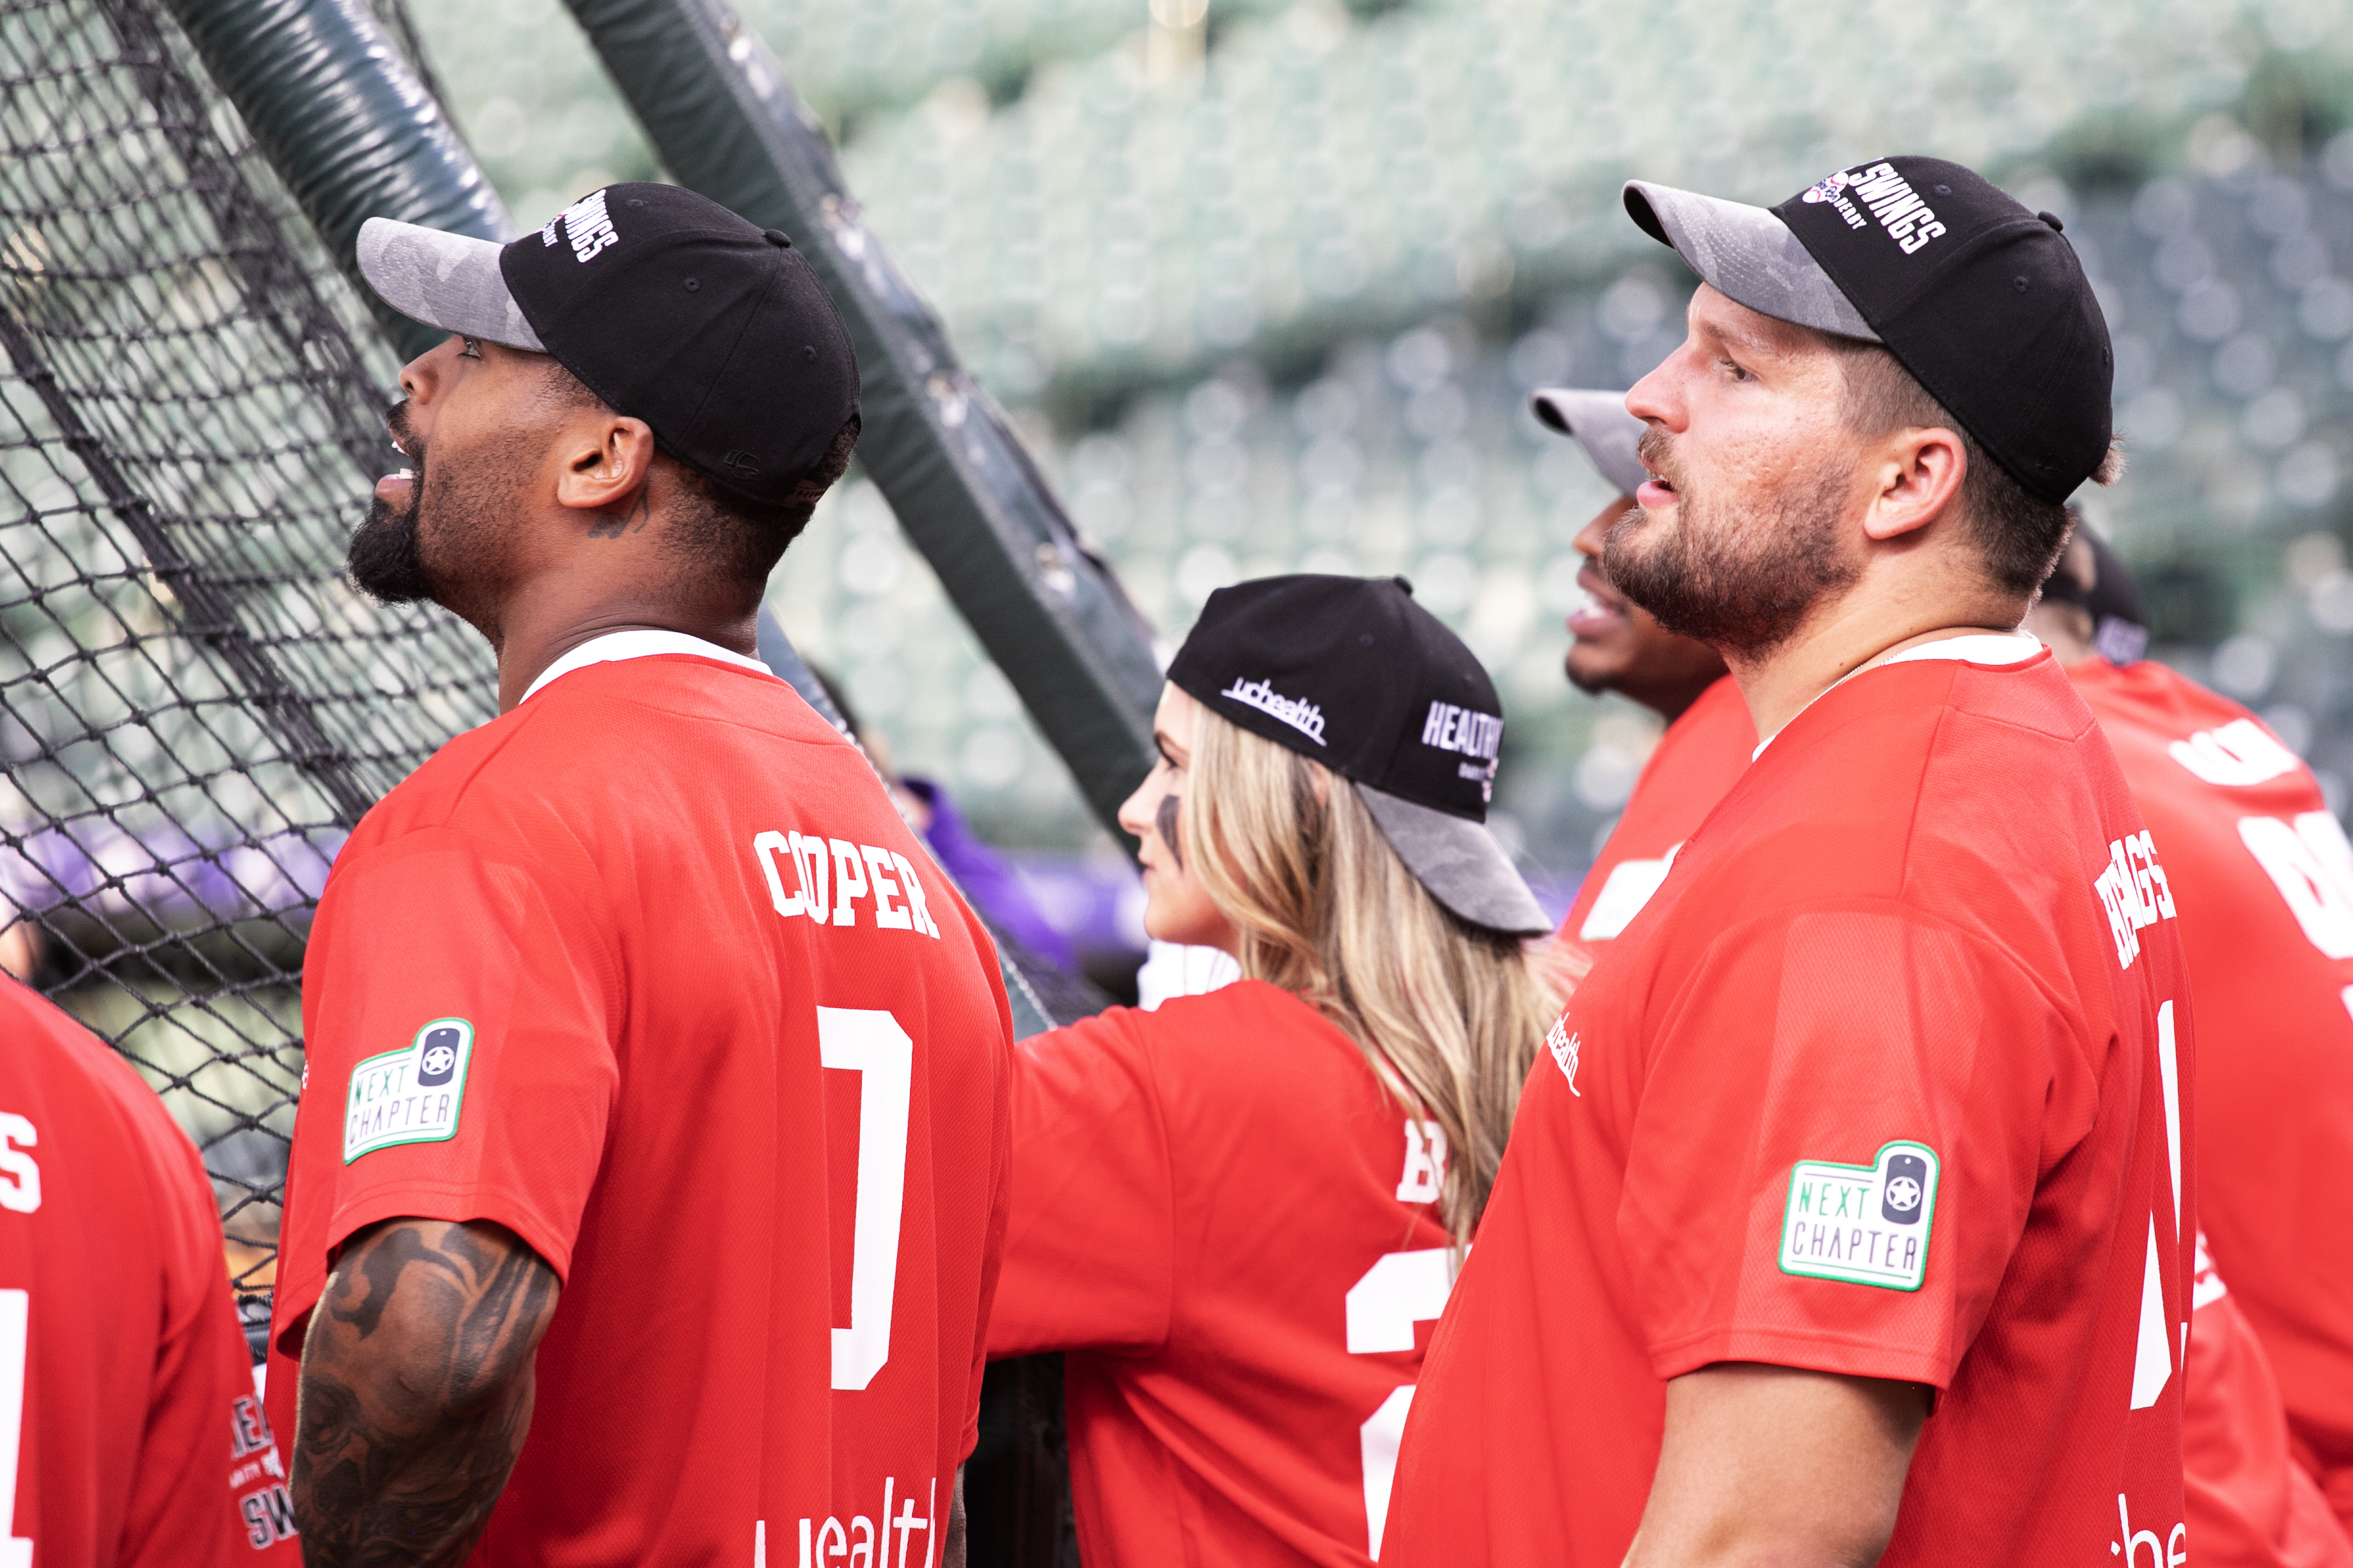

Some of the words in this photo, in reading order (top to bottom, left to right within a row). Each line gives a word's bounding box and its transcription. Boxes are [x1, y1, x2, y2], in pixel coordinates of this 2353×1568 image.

[1833, 196, 1867, 230] DERBY
[1848, 162, 1946, 254] SWINGS
[1221, 676, 1327, 747] uchealth
[353, 1065, 410, 1109] NEXT
[349, 1094, 450, 1145] CHAPTER
[1799, 1181, 1871, 1220] NEXT
[1792, 1220, 1918, 1271] CHAPTER
